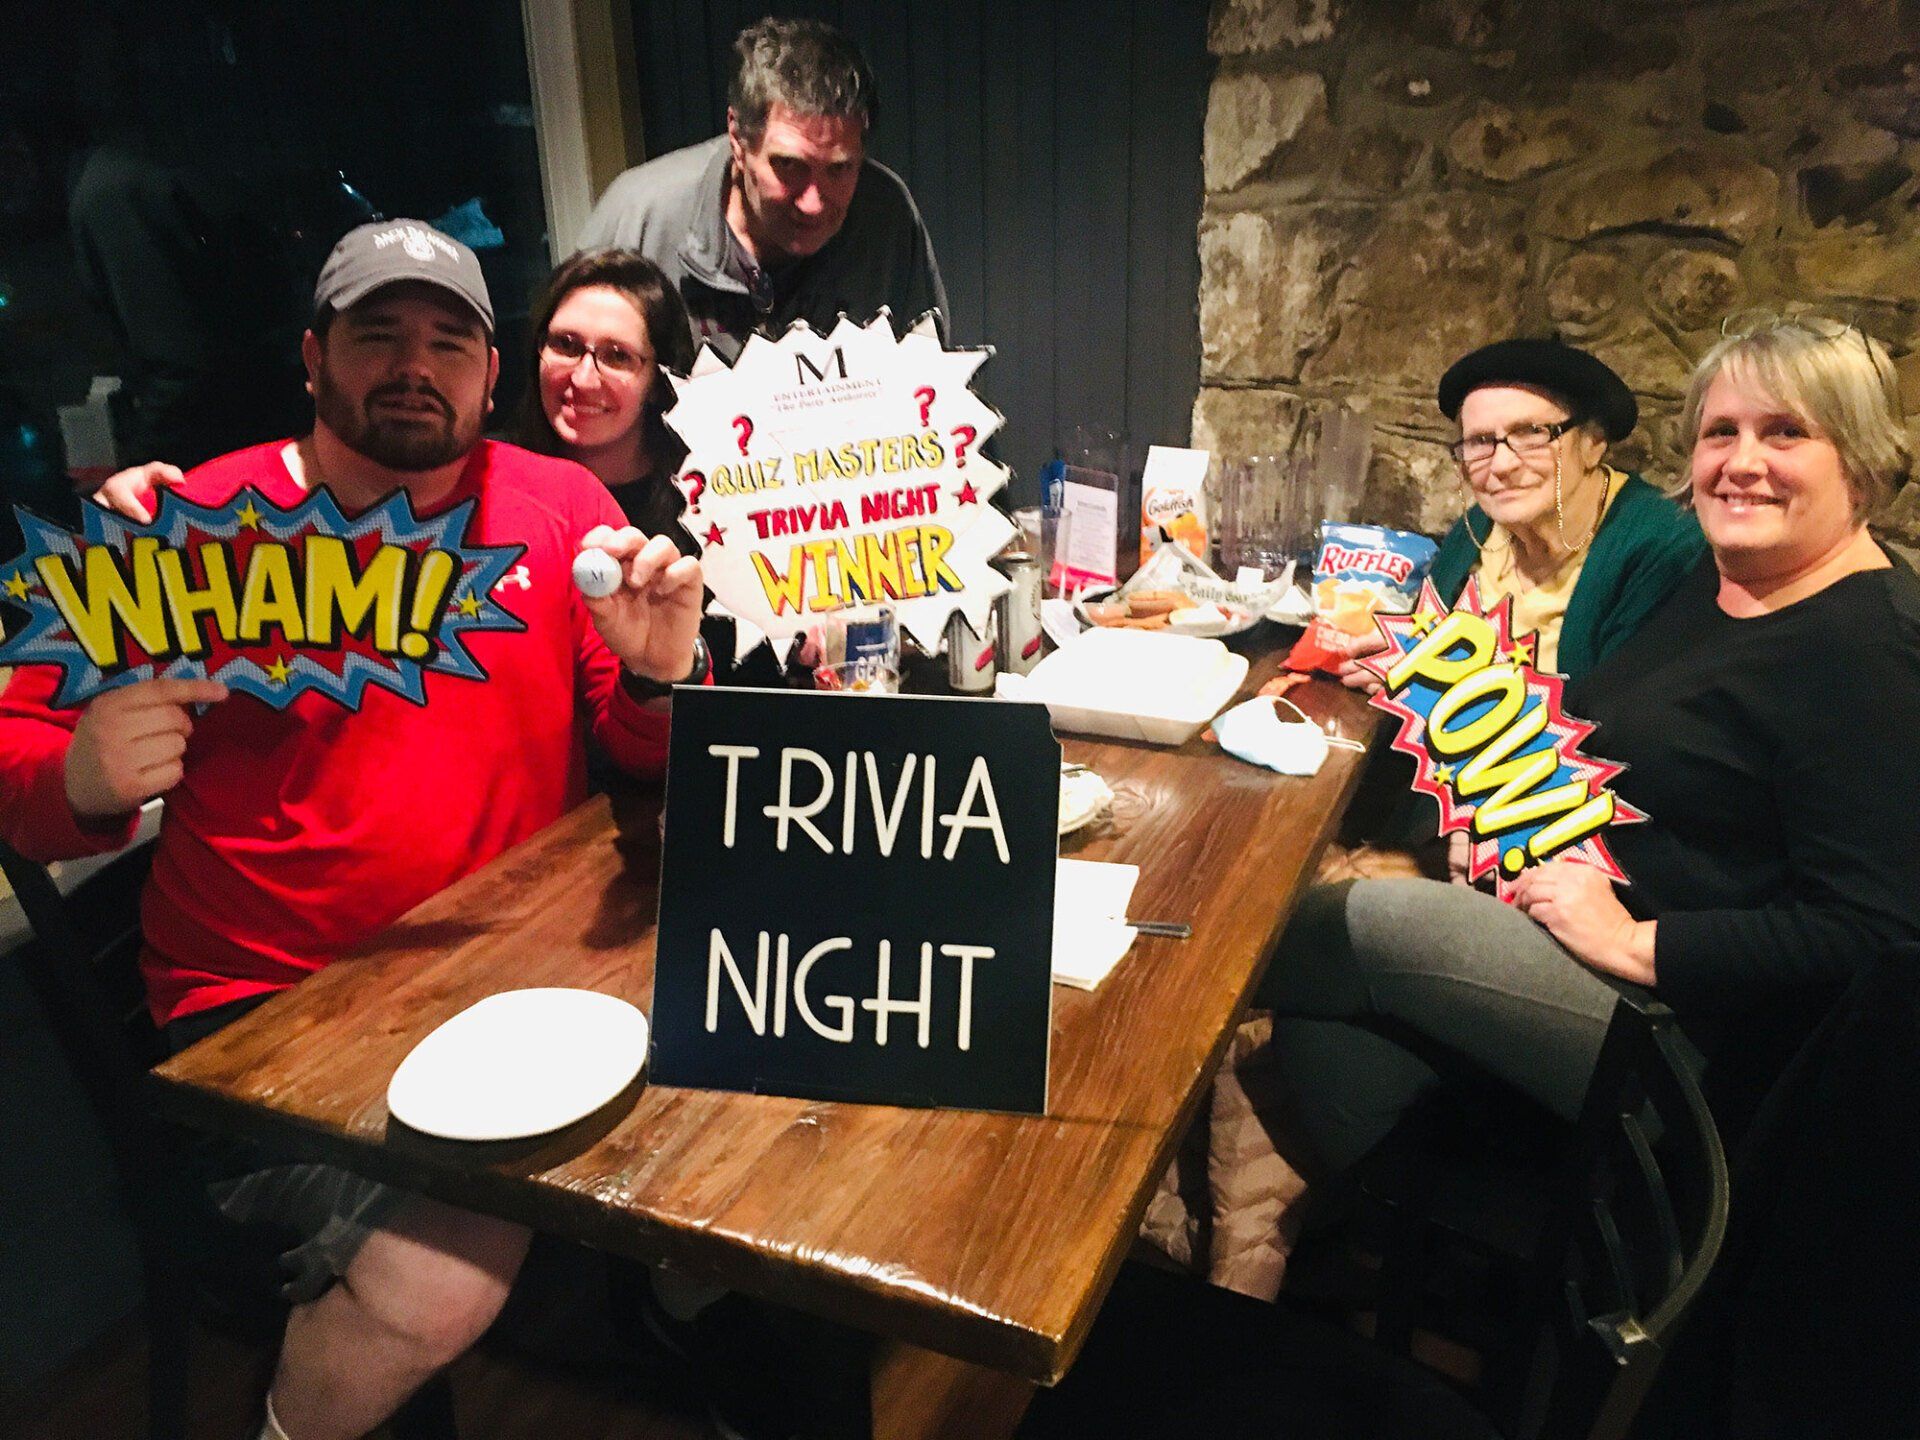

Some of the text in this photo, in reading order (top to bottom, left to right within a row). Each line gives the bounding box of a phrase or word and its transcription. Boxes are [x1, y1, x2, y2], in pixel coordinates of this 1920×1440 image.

[795, 346, 849, 385] M
[711, 430, 945, 497] QUIZ MASTERS
[748, 484, 941, 540] TRIVIA NIGHT
[35, 534, 460, 668] WHAM!
[750, 523, 966, 617] WINNER
[1319, 543, 1413, 584] RUFFLES
[1386, 610, 1615, 873] POW!
[708, 744, 1011, 865] TRIVIA
[705, 927, 996, 1052] NIGHT
